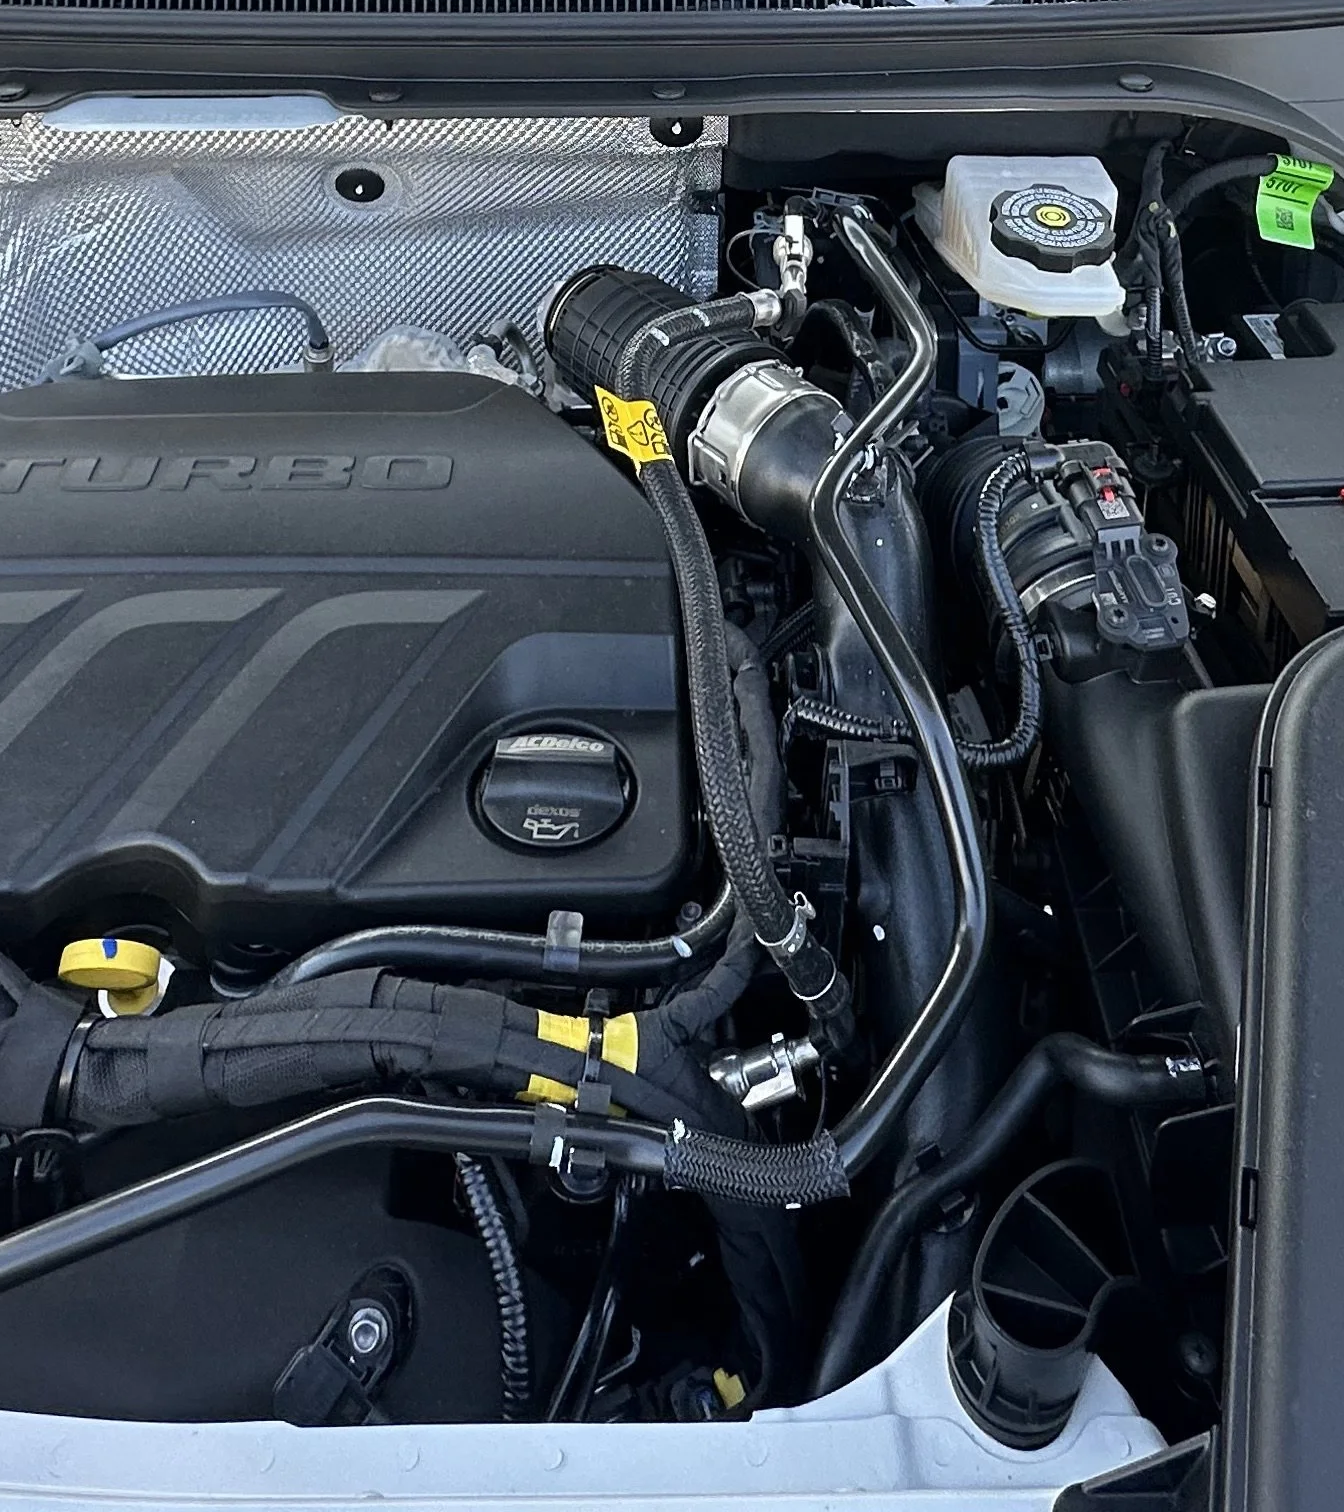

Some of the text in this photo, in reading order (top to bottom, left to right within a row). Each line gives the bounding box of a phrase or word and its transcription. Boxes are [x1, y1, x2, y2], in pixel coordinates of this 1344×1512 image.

[1266, 176, 1304, 193] 5707
[509, 736, 605, 753] ACDelco
[527, 804, 581, 818] dexos
